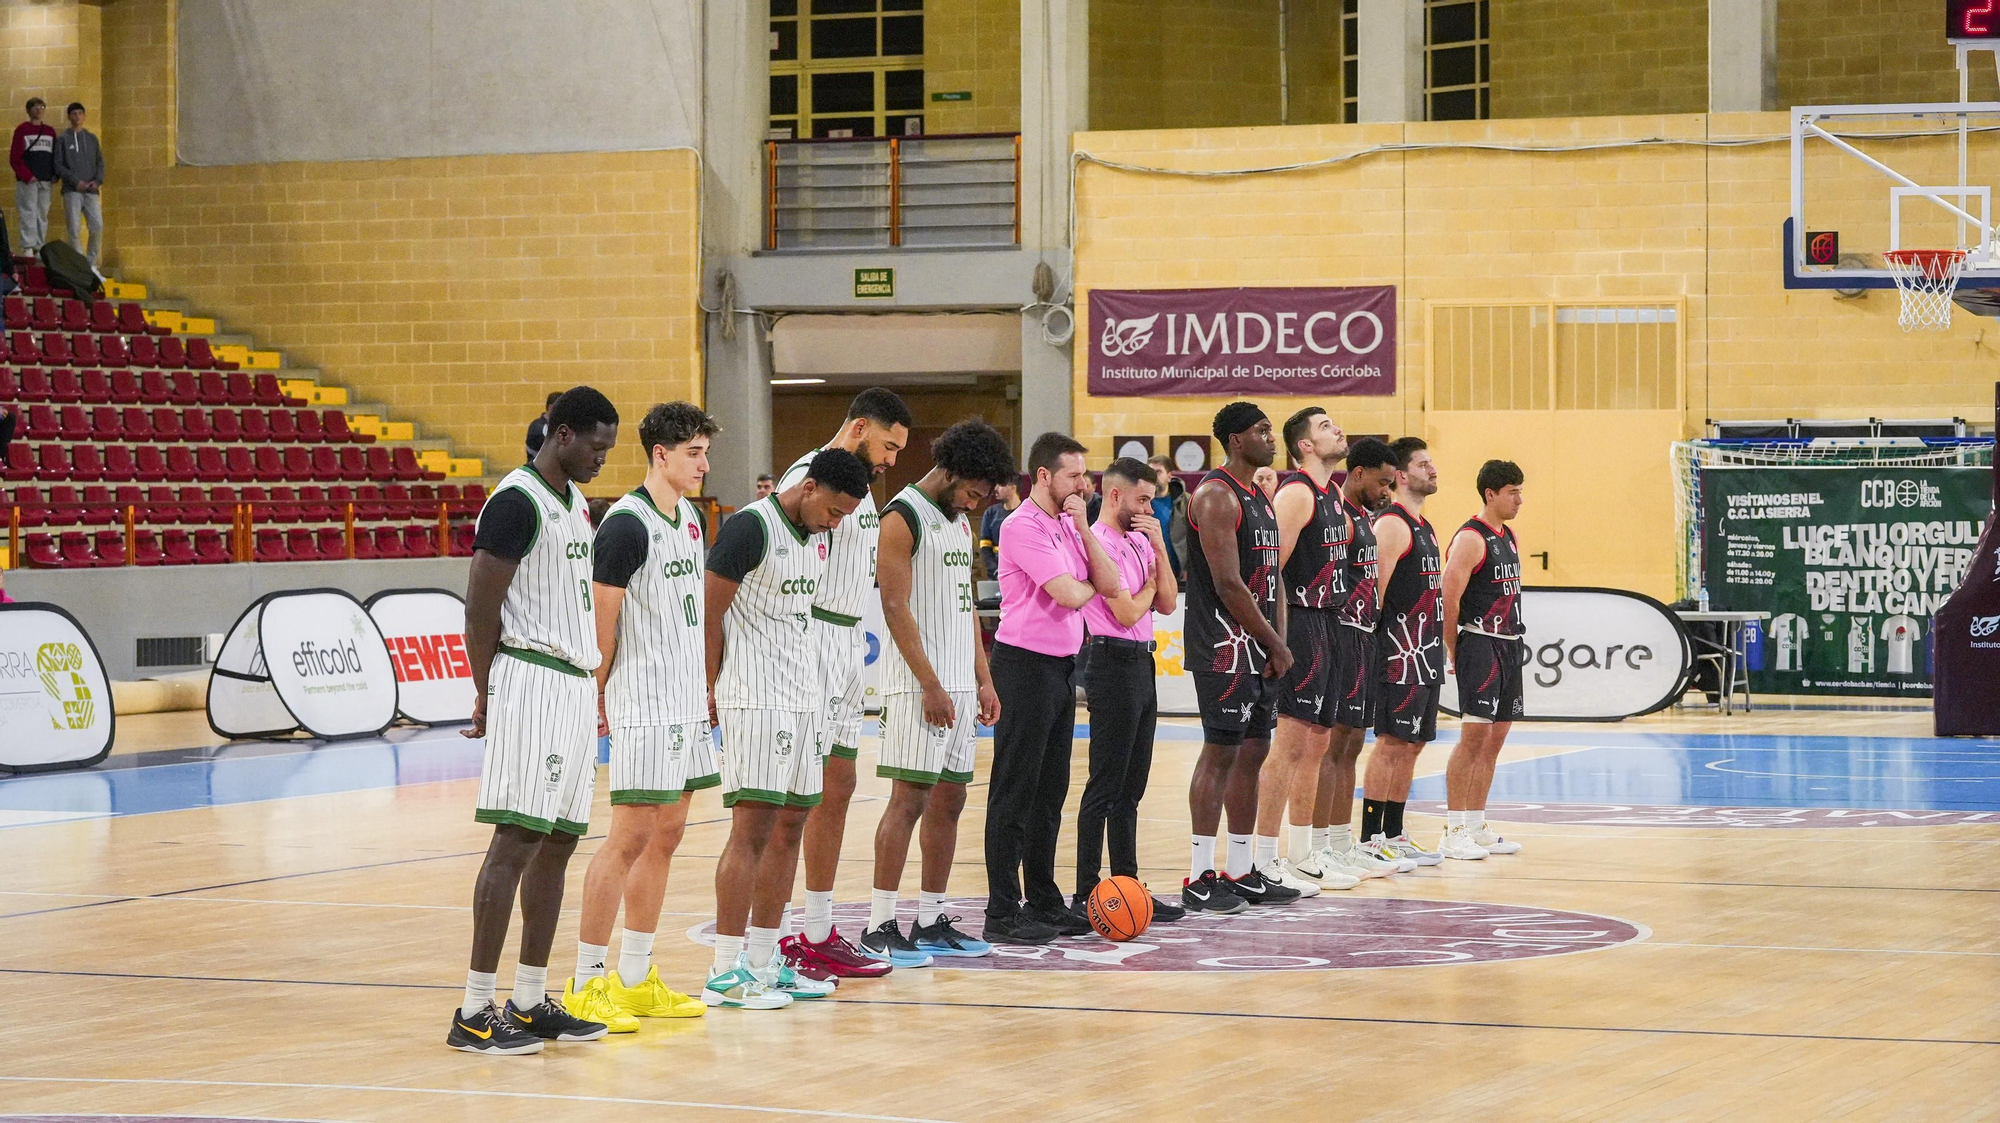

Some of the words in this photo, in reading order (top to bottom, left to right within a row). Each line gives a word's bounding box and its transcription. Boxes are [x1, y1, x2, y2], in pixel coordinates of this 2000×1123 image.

[1166, 311, 1384, 355] IMDECO
[1101, 365, 1158, 379] Instituto
[1160, 365, 1229, 381] Municipal
[1232, 365, 1250, 378] de
[1254, 365, 1318, 380] Deportes
[1321, 364, 1381, 378] Córdoba
[1726, 492, 1790, 507] VISÍTANOS
[1790, 493, 1808, 505] EN
[1808, 493, 1825, 505] EL
[1861, 480, 1895, 509] CCB
[1727, 508, 1750, 520] C.C.
[1750, 507, 1766, 519] LA
[1766, 506, 1811, 518] SIERRA
[1783, 525, 1849, 549] LUCE
[1851, 523, 1888, 547] TU
[1889, 521, 1986, 546] ORGUL
[943, 548, 970, 567] coto
[1805, 543, 1973, 570] BLANQUIVER
[780, 575, 815, 595] coto
[1332, 568, 1347, 594] 21
[1806, 569, 1912, 594] DENTRO
[1913, 568, 1933, 592] Y
[683, 594, 698, 627] 10
[1811, 589, 1846, 612] DE
[1848, 591, 1883, 613] LA
[1885, 591, 1950, 616] CAN
[292, 638, 362, 677] efficold
[385, 633, 472, 683] EWIS
[1970, 641, 2000, 649] Instituto
